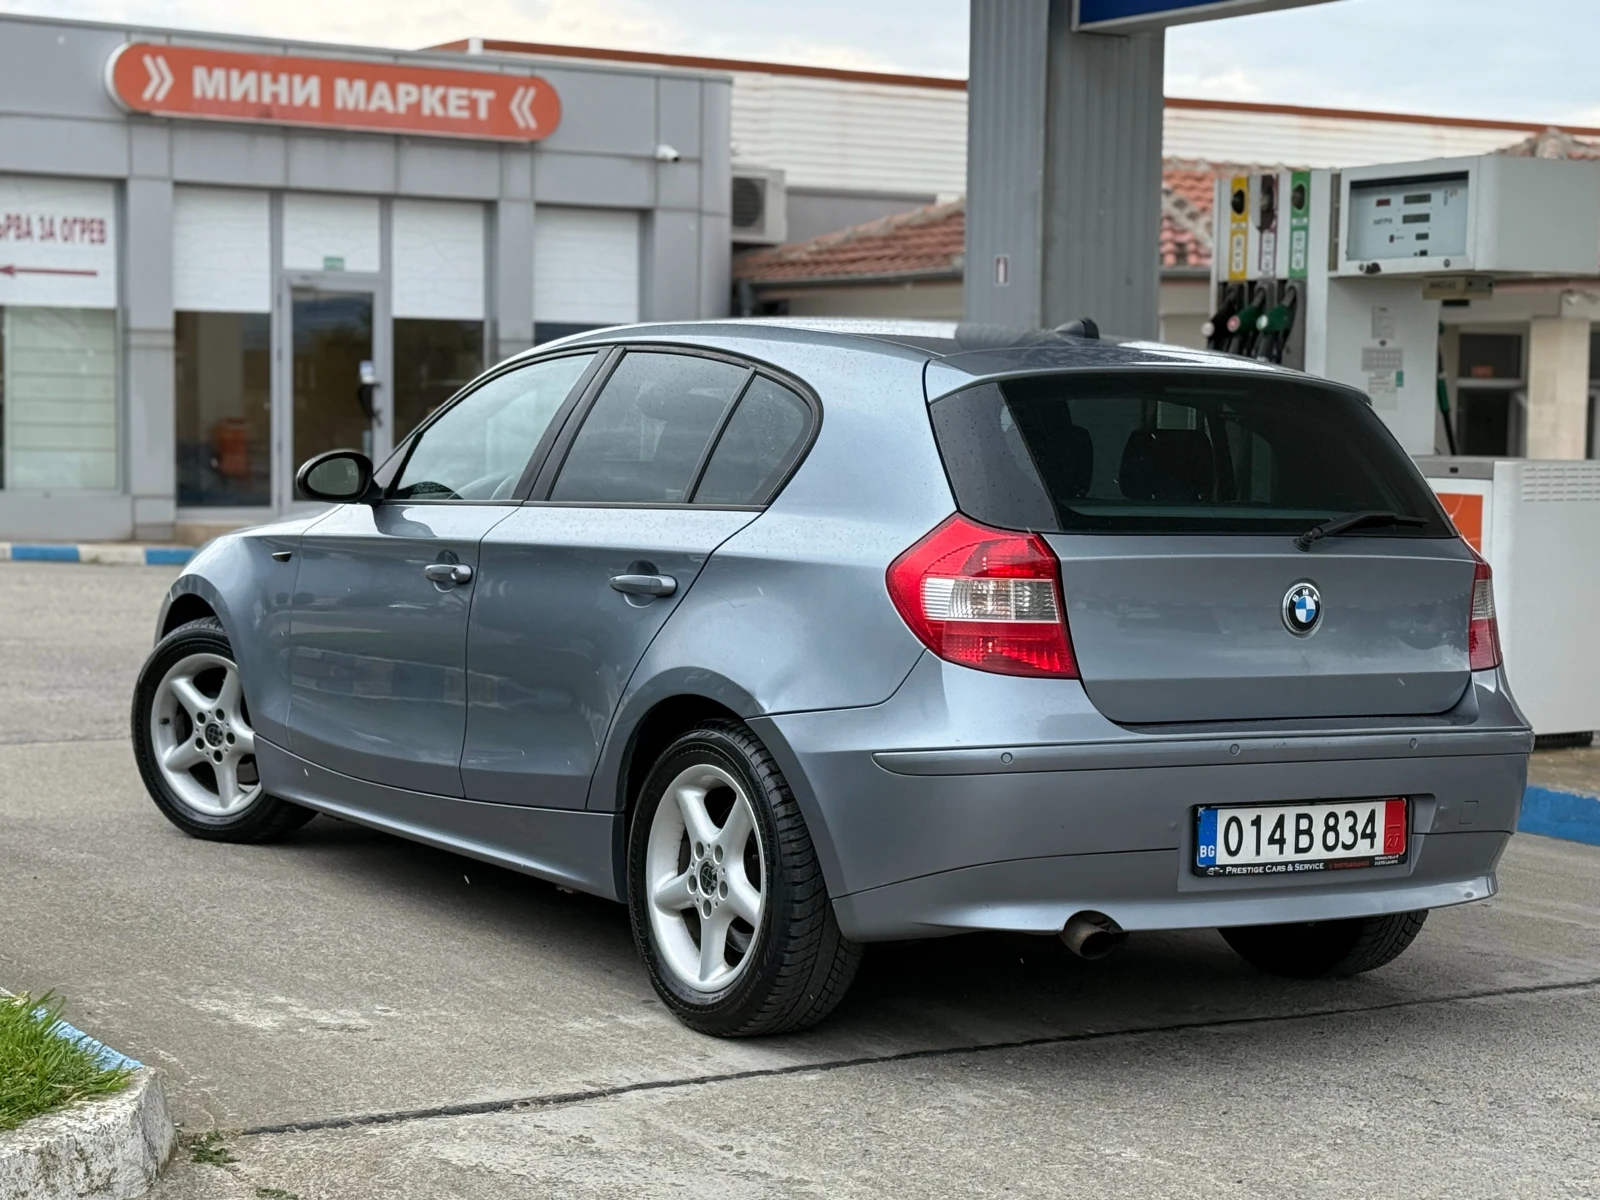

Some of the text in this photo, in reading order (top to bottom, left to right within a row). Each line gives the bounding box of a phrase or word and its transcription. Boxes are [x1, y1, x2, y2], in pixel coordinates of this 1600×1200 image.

[192, 66, 496, 120] МИНИ МАРКЕТ
[39, 214, 55, 242] ЗА
[62, 216, 106, 244] ОГРЕВ
[1200, 845, 1215, 857] BG
